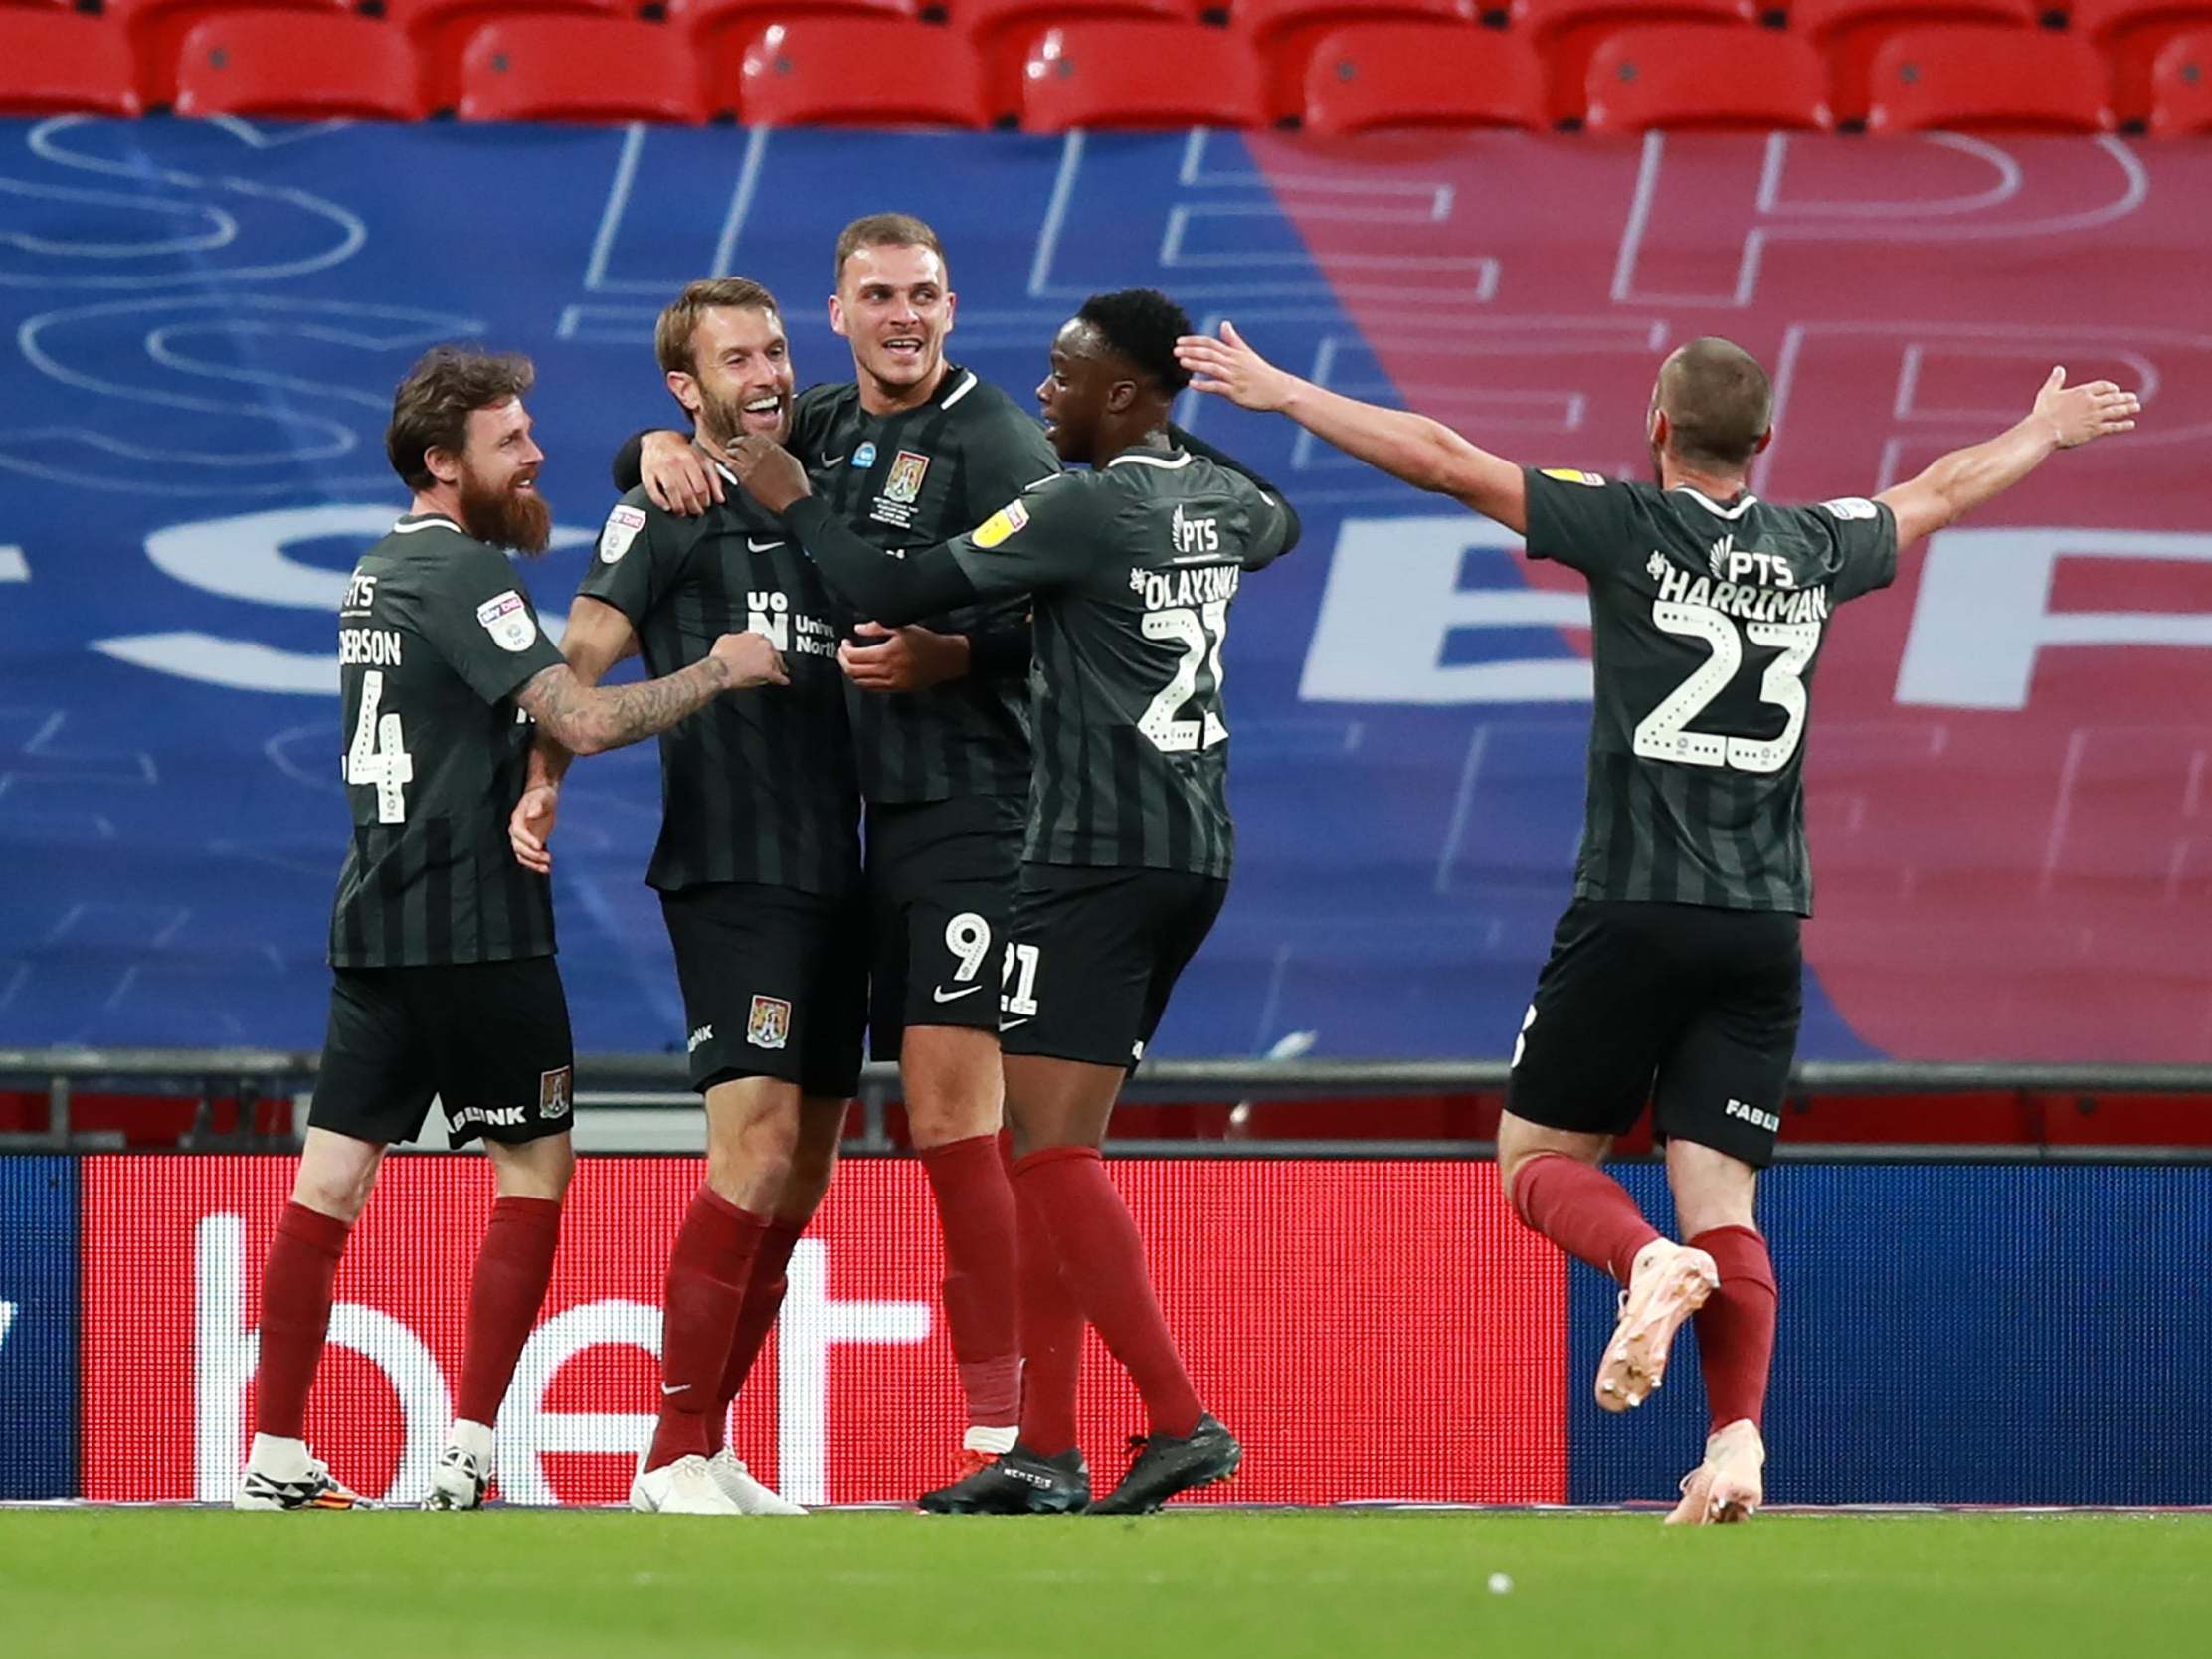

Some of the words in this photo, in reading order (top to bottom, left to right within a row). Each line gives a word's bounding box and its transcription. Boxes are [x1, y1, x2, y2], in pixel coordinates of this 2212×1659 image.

[1183, 517, 1219, 553] PTS
[1729, 550, 1795, 590] PTS
[1658, 565, 1828, 625] HARRIMAN
[1137, 599, 1230, 753] 21
[1633, 599, 1822, 773] 23
[945, 911, 992, 981] 9
[194, 1211, 931, 1506] bet
